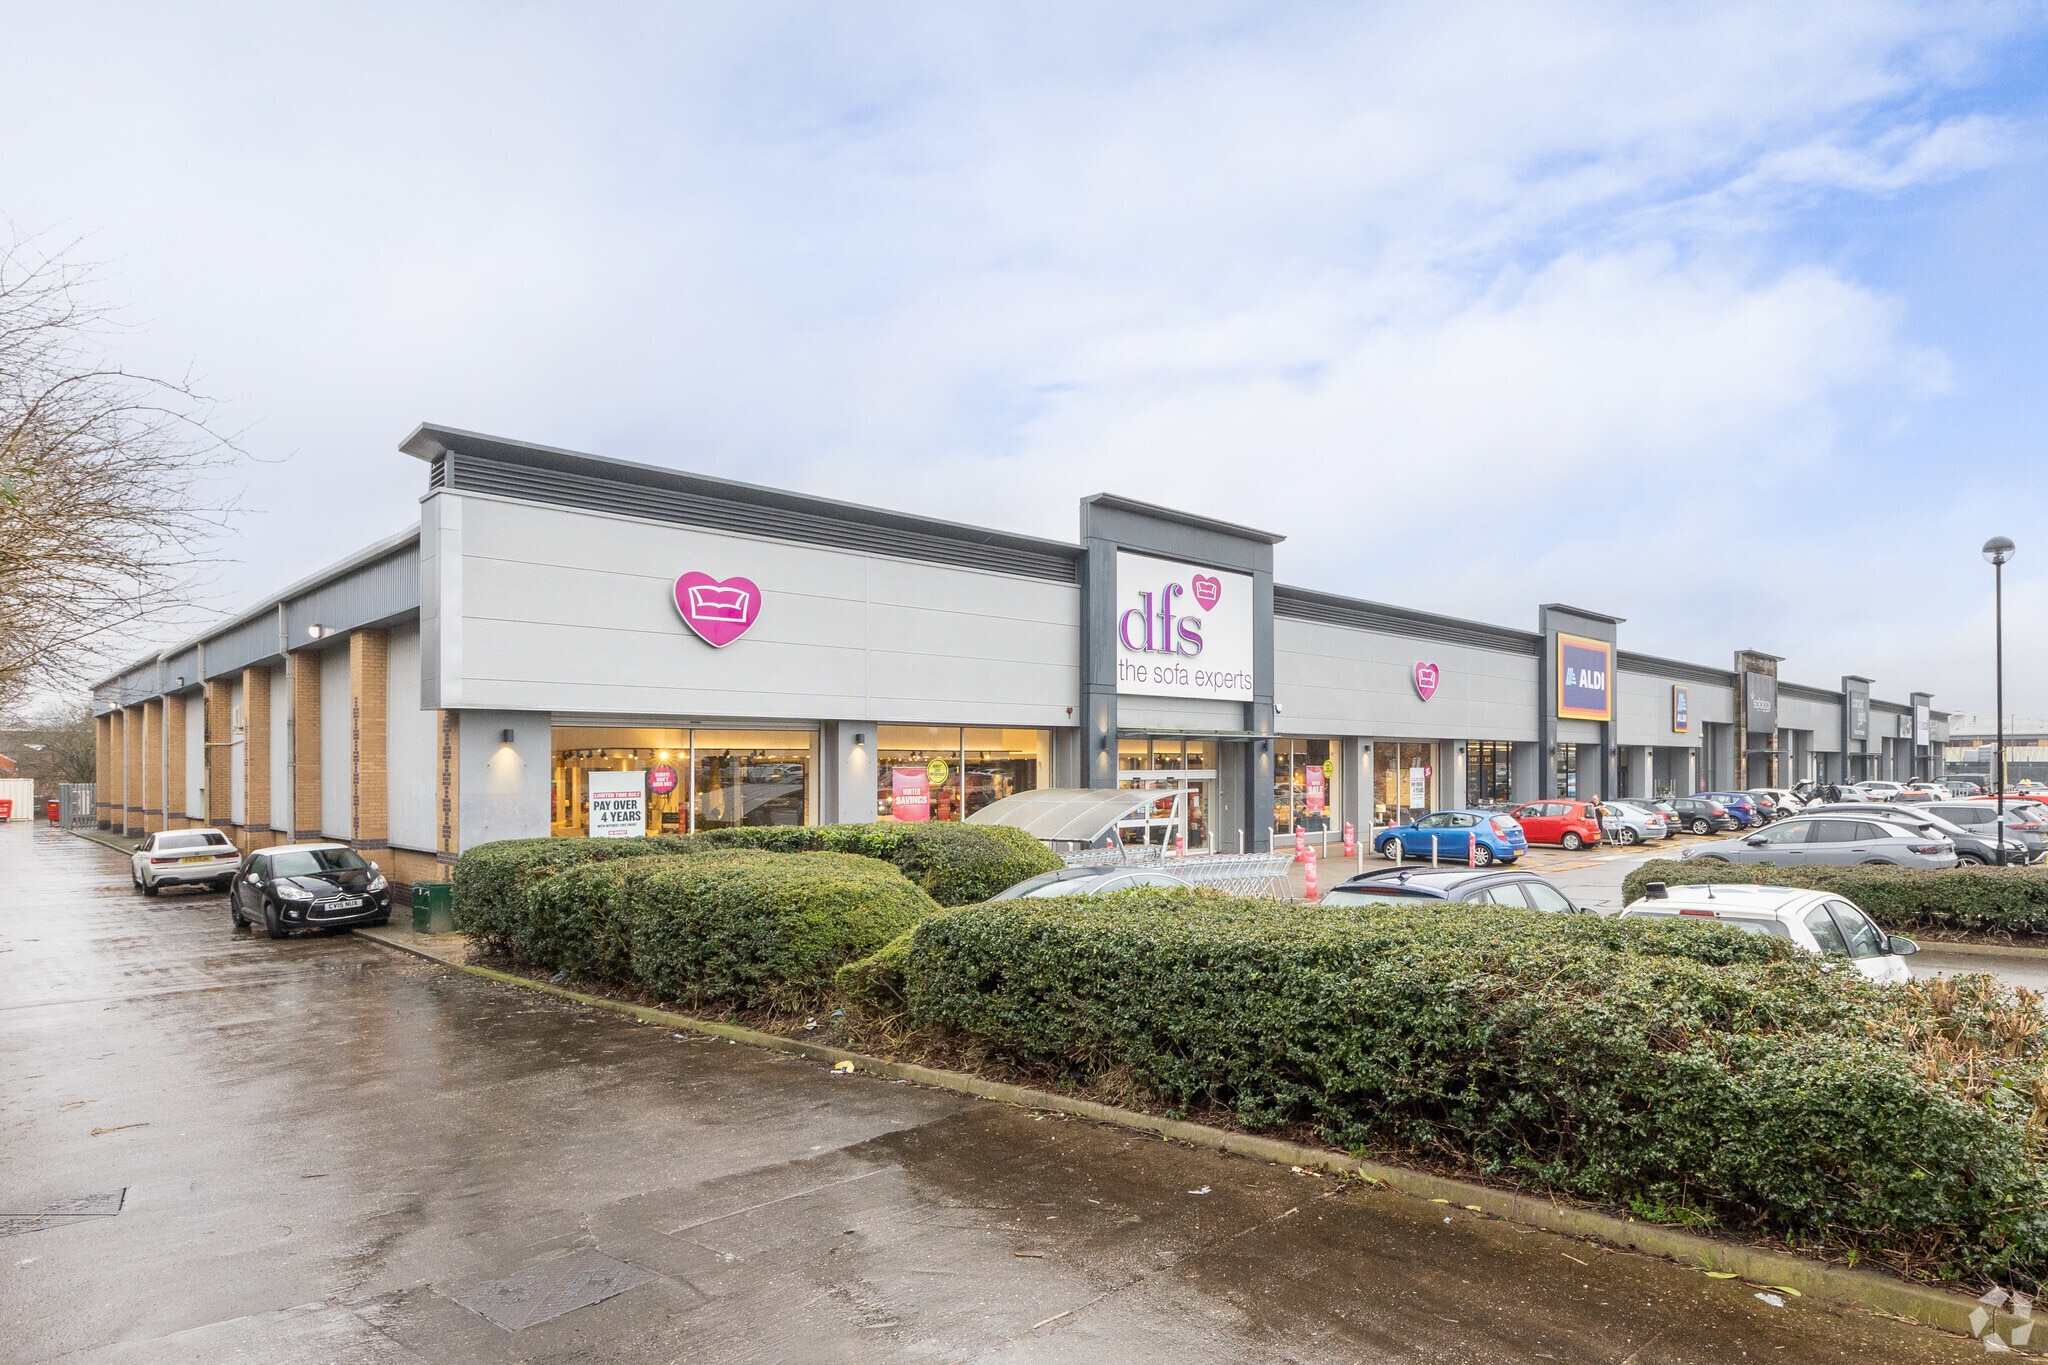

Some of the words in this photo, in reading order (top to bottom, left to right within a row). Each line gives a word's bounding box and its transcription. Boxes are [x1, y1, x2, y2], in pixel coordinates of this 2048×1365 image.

[1119, 583, 1203, 657] dfs
[1118, 658, 1147, 683] the
[1153, 663, 1188, 686] sofa
[1195, 670, 1252, 692] experts
[1579, 668, 1604, 690] ALDI
[1677, 713, 1686, 722] ALDI
[1308, 786, 1324, 794] SALE
[593, 801, 611, 811] PAY
[613, 800, 637, 810] OVER
[895, 796, 928, 805] SAVINGS
[601, 812, 608, 822] 4
[610, 811, 641, 822] YEARS
